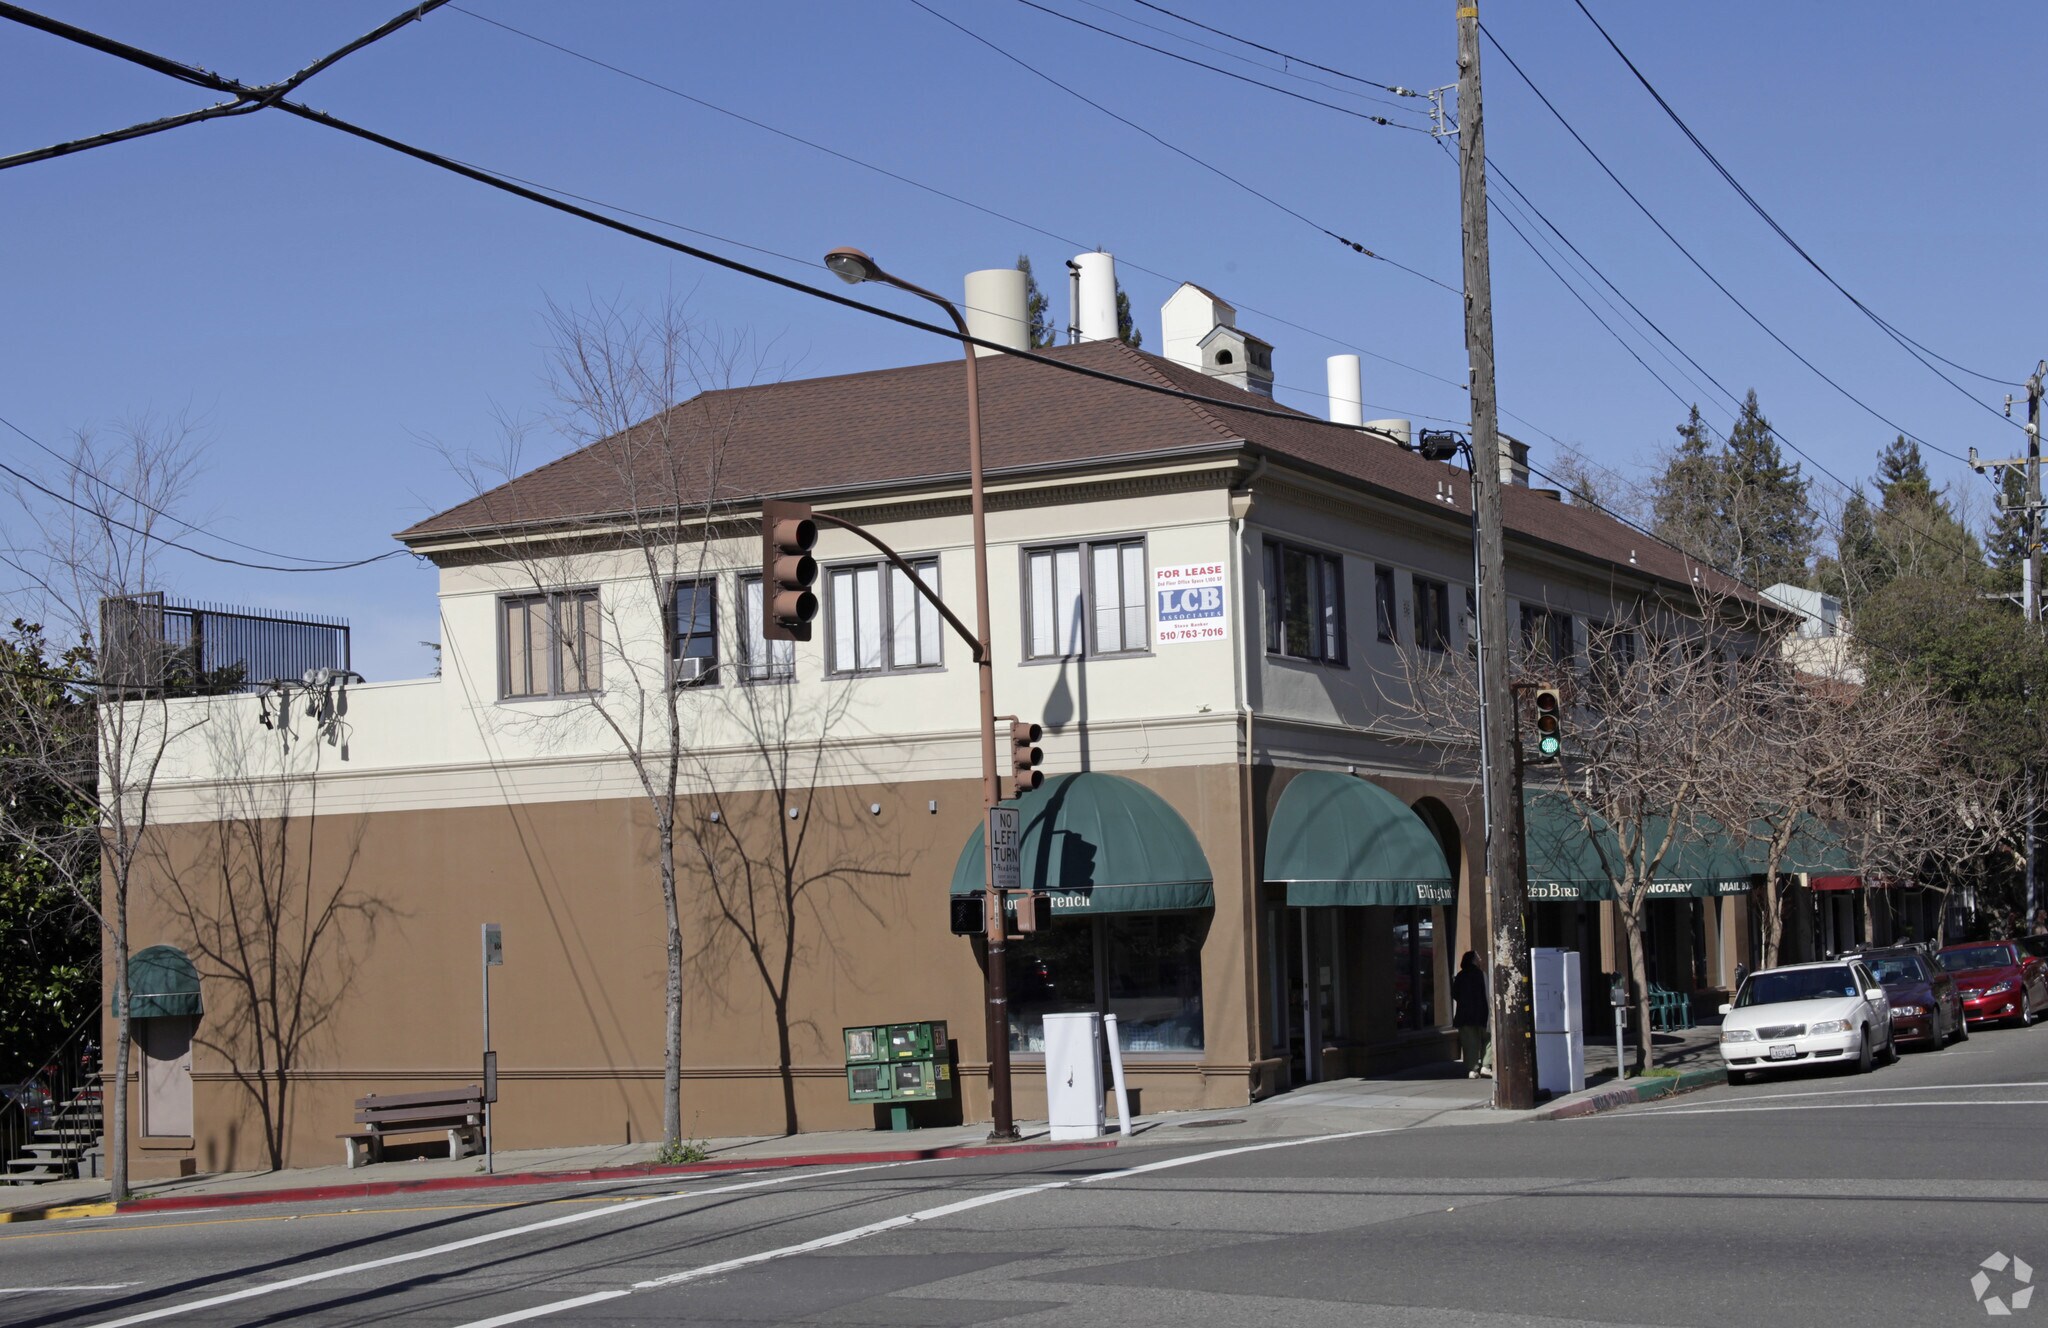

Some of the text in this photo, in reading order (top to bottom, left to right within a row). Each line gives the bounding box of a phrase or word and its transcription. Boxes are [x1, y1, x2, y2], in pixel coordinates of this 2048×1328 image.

[1157, 566, 1221, 579] FOR LEASE
[1160, 587, 1221, 614] LCB
[1162, 611, 1221, 621] ASSOCIATES
[1160, 628, 1223, 640] 510/763-7016
[1000, 813, 1012, 828] NO
[994, 830, 1017, 846] LEFT
[993, 847, 1018, 862] TURN
[1647, 883, 1692, 893] NOTARY
[1719, 882, 1741, 891] MAIL
[1047, 891, 1091, 909] rench
